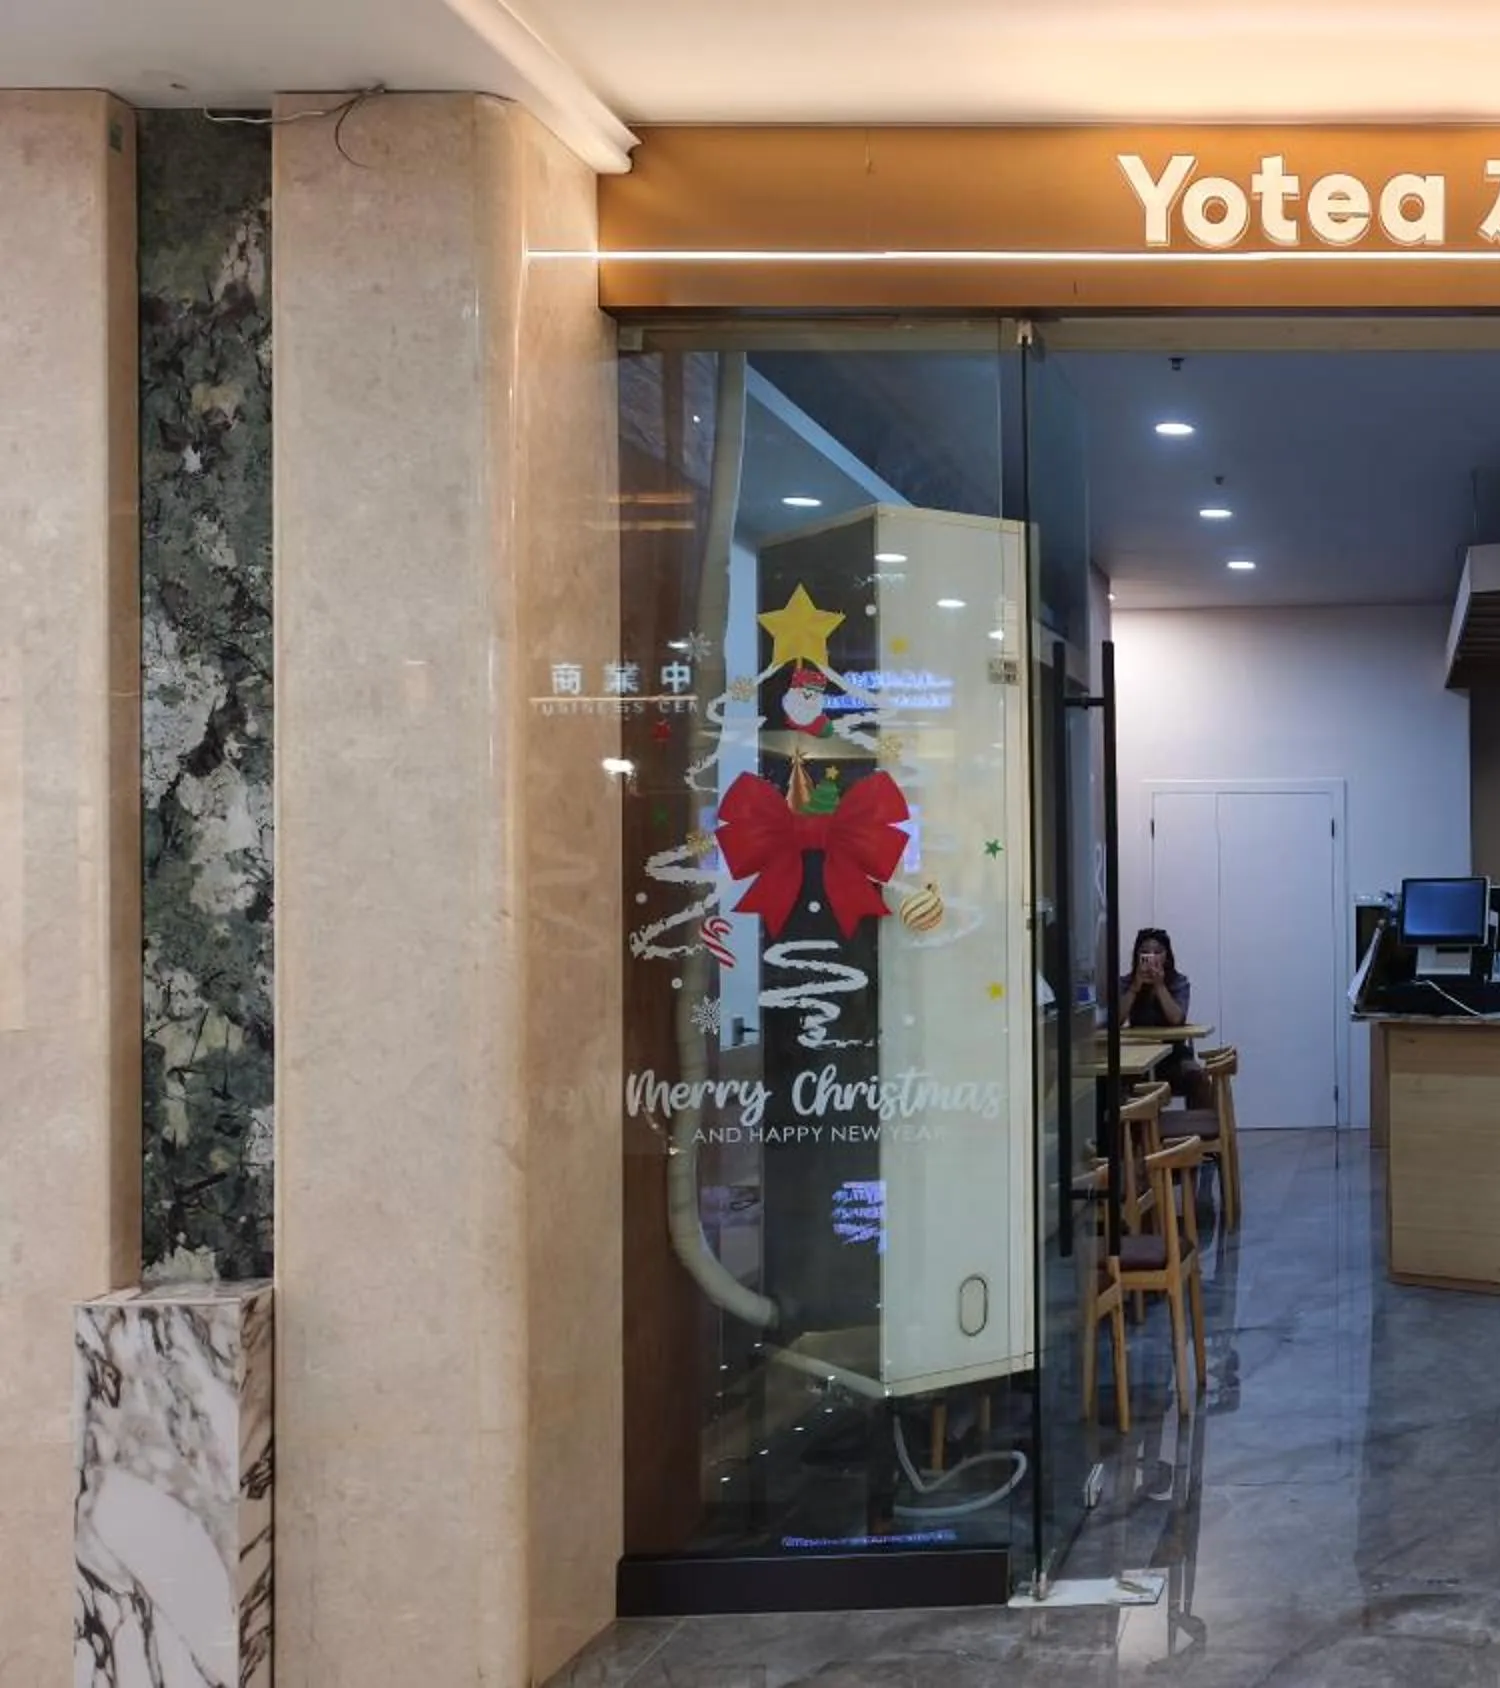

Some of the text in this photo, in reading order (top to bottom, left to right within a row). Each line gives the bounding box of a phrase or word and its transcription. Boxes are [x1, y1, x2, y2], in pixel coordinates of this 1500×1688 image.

[1117, 154, 1446, 248] Yotea
[625, 1062, 1008, 1127] Merry Christmas
[690, 1126, 743, 1144] AND
[750, 1125, 824, 1144] HAPPY
[830, 1124, 882, 1144] NEW
